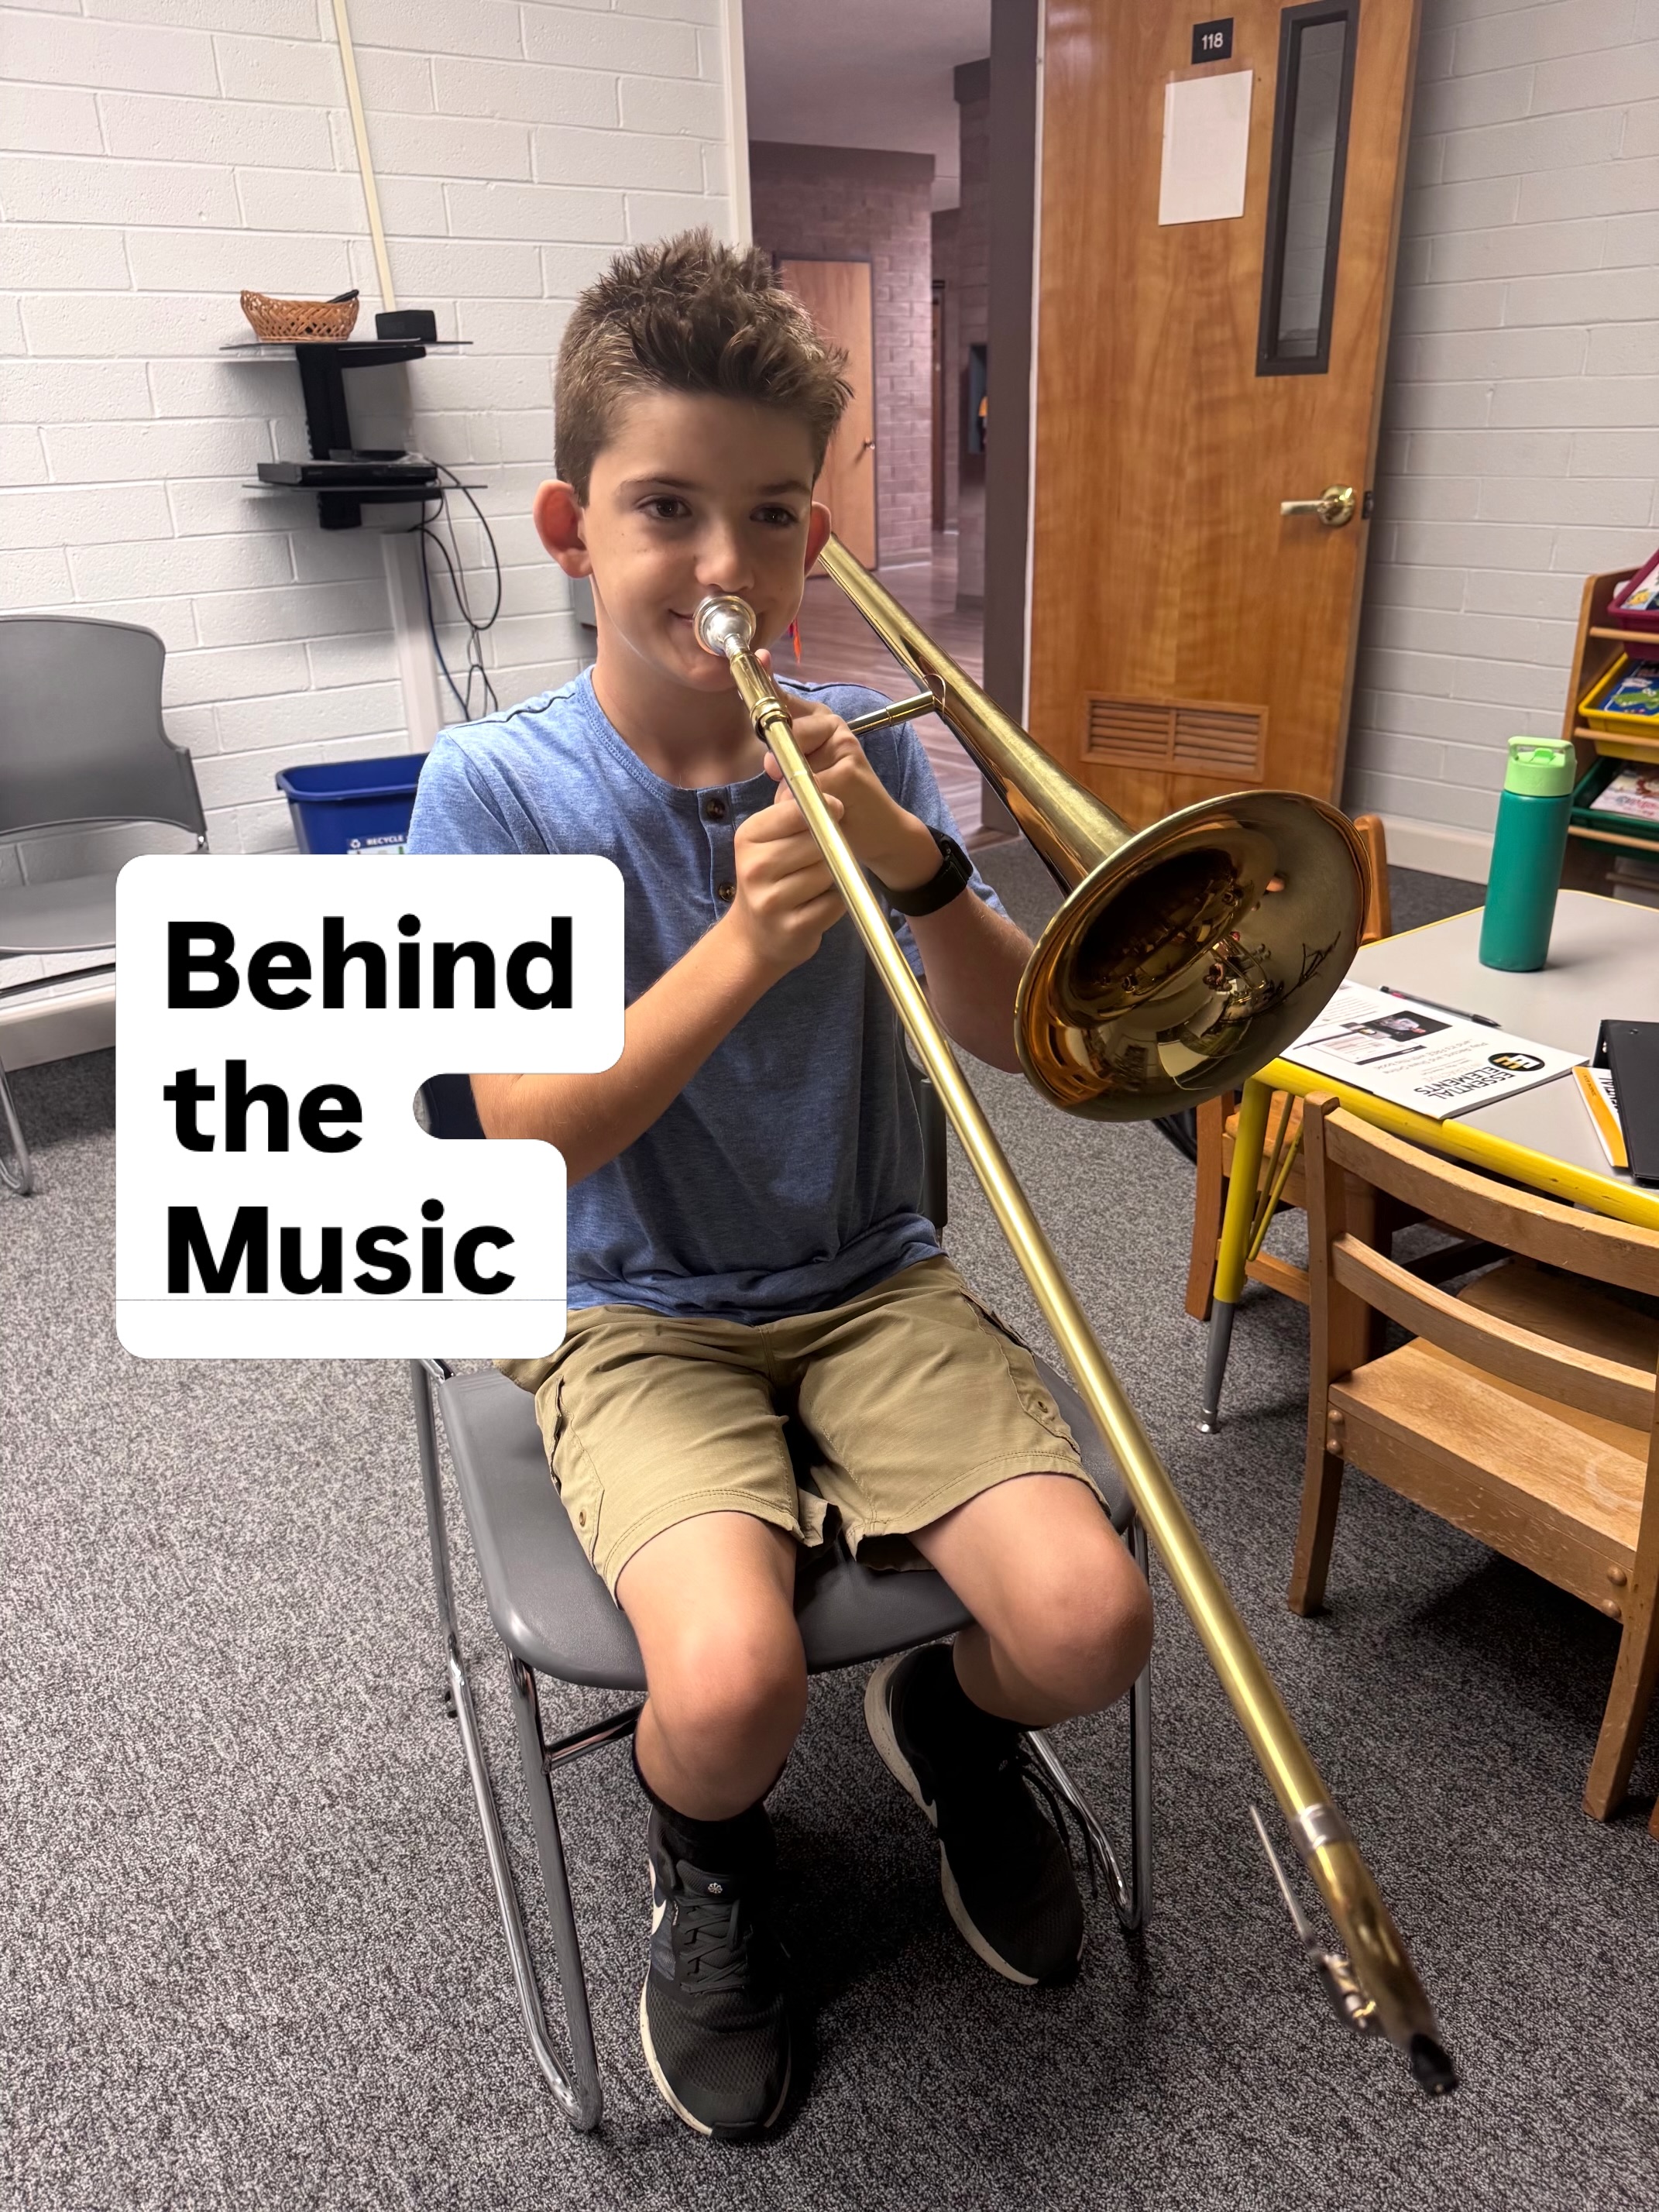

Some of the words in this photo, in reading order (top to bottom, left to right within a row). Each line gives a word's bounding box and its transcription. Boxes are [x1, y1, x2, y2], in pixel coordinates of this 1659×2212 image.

[1201, 32, 1224, 50] 118
[366, 834, 404, 846] RECYCLE
[1413, 1066, 1500, 1095] ELEMENTS
[1427, 1070, 1515, 1100] ESSENTIAL
